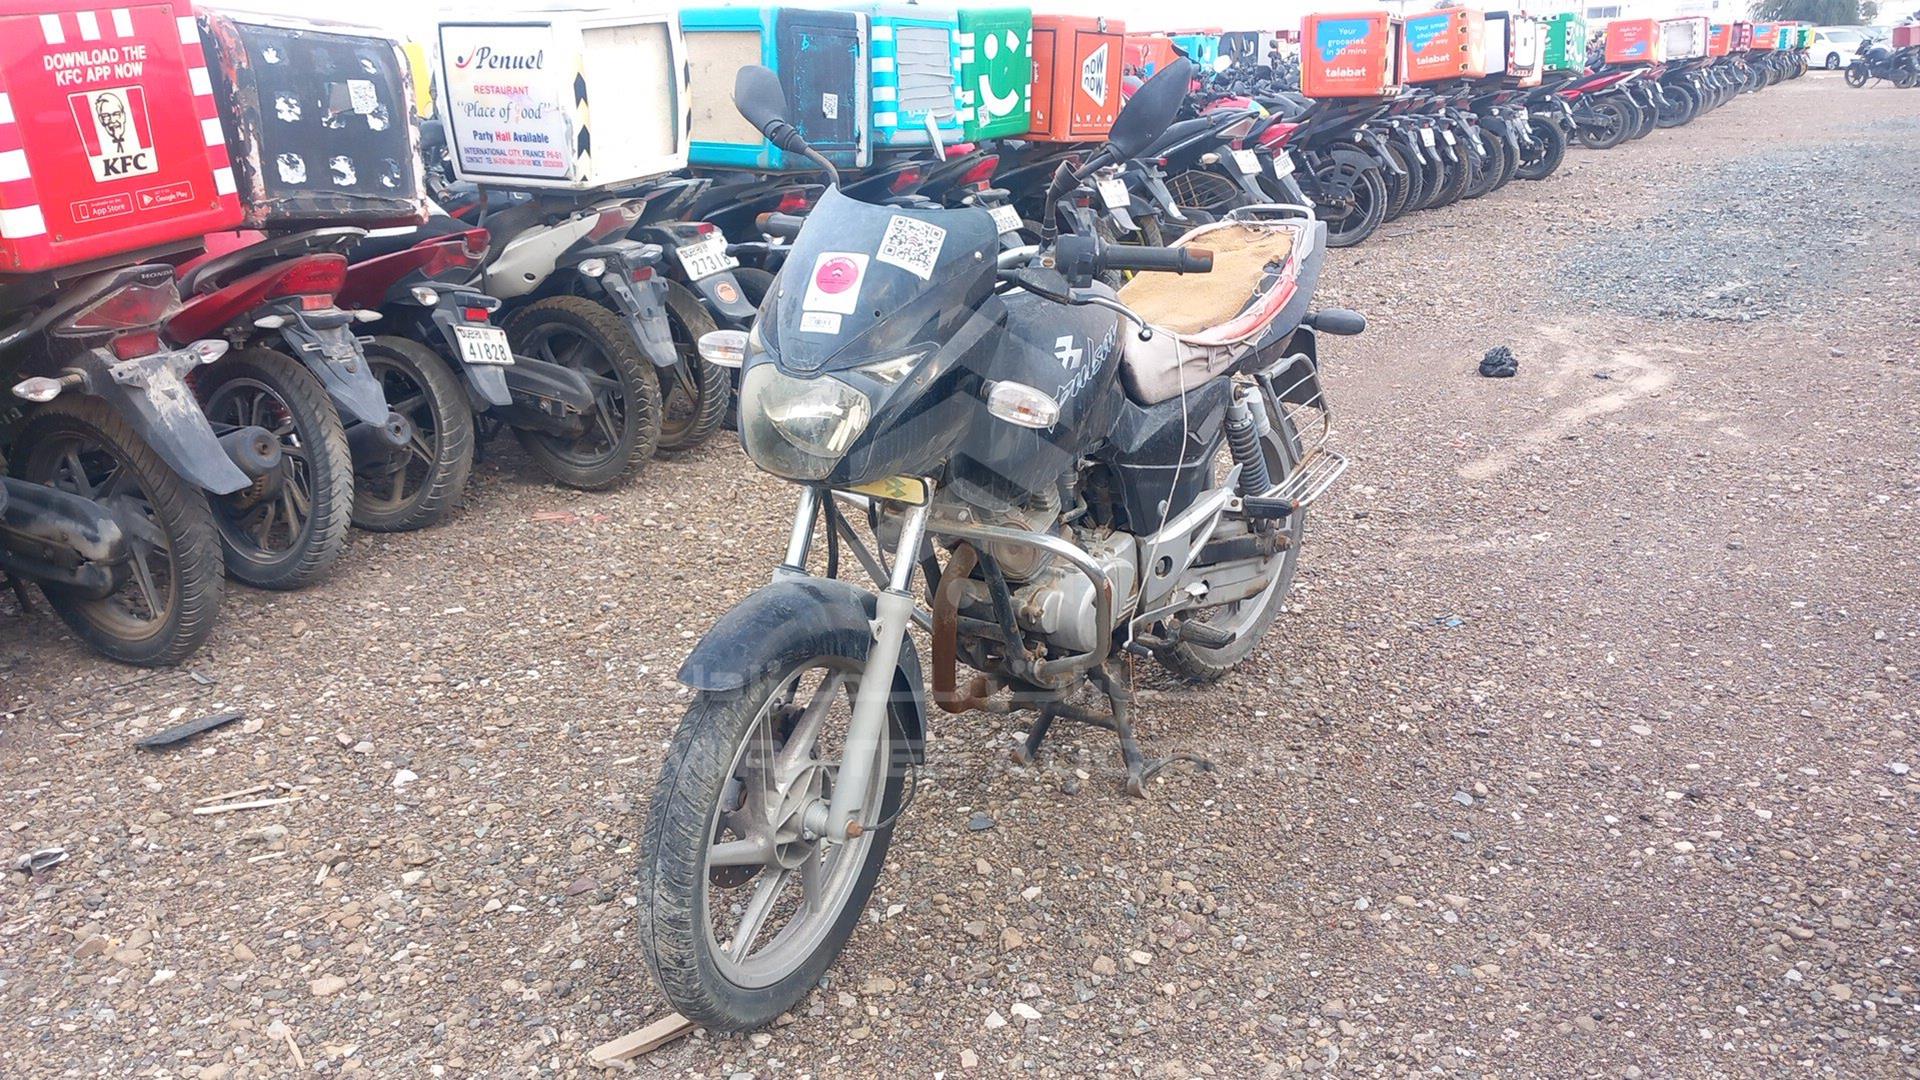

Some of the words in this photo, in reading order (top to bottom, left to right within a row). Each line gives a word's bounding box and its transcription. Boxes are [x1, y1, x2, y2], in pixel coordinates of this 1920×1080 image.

[1338, 27, 1357, 36] Your
[43, 48, 119, 70] DOWNLOAD
[121, 45, 147, 61] THE
[475, 46, 544, 70] Penuel
[1326, 48, 1334, 56] in
[1335, 48, 1346, 56] 30
[1347, 47, 1367, 55] mins
[1416, 54, 1450, 65] talabat
[55, 69, 83, 86] KFC
[86, 66, 111, 82] APP
[115, 62, 143, 79] NOW
[1325, 66, 1367, 78] talabat
[473, 85, 529, 96] RESTAURANT
[499, 101, 512, 124] of
[472, 130, 494, 142] Party
[495, 131, 512, 142] Hall
[513, 131, 550, 144] Available
[464, 147, 507, 156] INTERNATIONAL
[522, 149, 546, 159] FRANCE
[102, 153, 148, 177] KFC
[155, 193, 176, 203] Google
[176, 191, 188, 200] Play
[92, 206, 106, 216] App
[107, 203, 125, 213] Store
[469, 342, 508, 361] 41828
